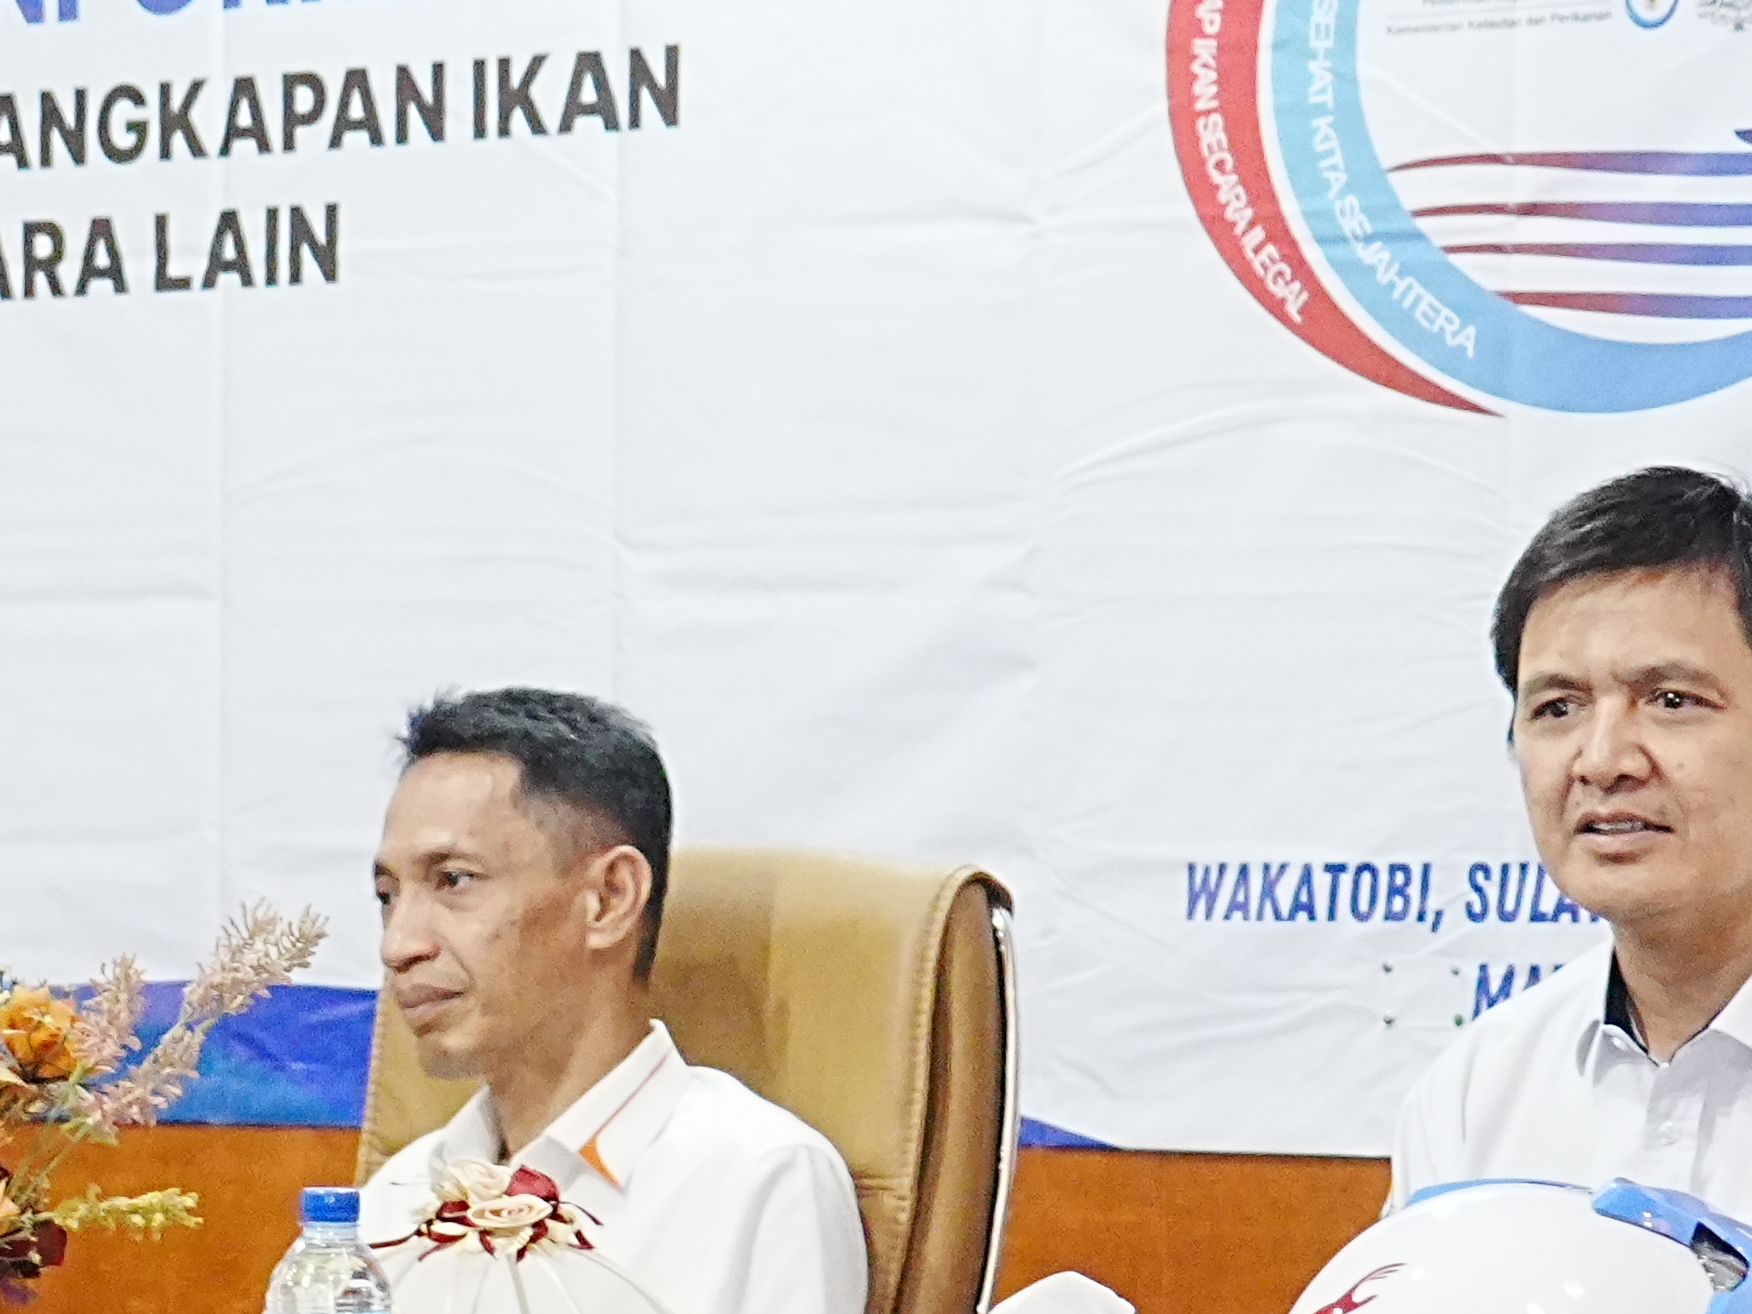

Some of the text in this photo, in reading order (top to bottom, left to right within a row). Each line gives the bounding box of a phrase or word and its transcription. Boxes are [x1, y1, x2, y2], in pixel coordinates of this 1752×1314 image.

[473, 45, 678, 139] IKAN
[1190, 37, 1219, 111] IKAN
[1196, 112, 1254, 236] SECARA
[155, 204, 337, 292] LAIN
[1241, 224, 1311, 324] ILEGAL
[1311, 115, 1347, 200] KITA
[1334, 193, 1477, 359] SEJAHTERA
[1186, 861, 1602, 933] WAKATOBI, SULA
